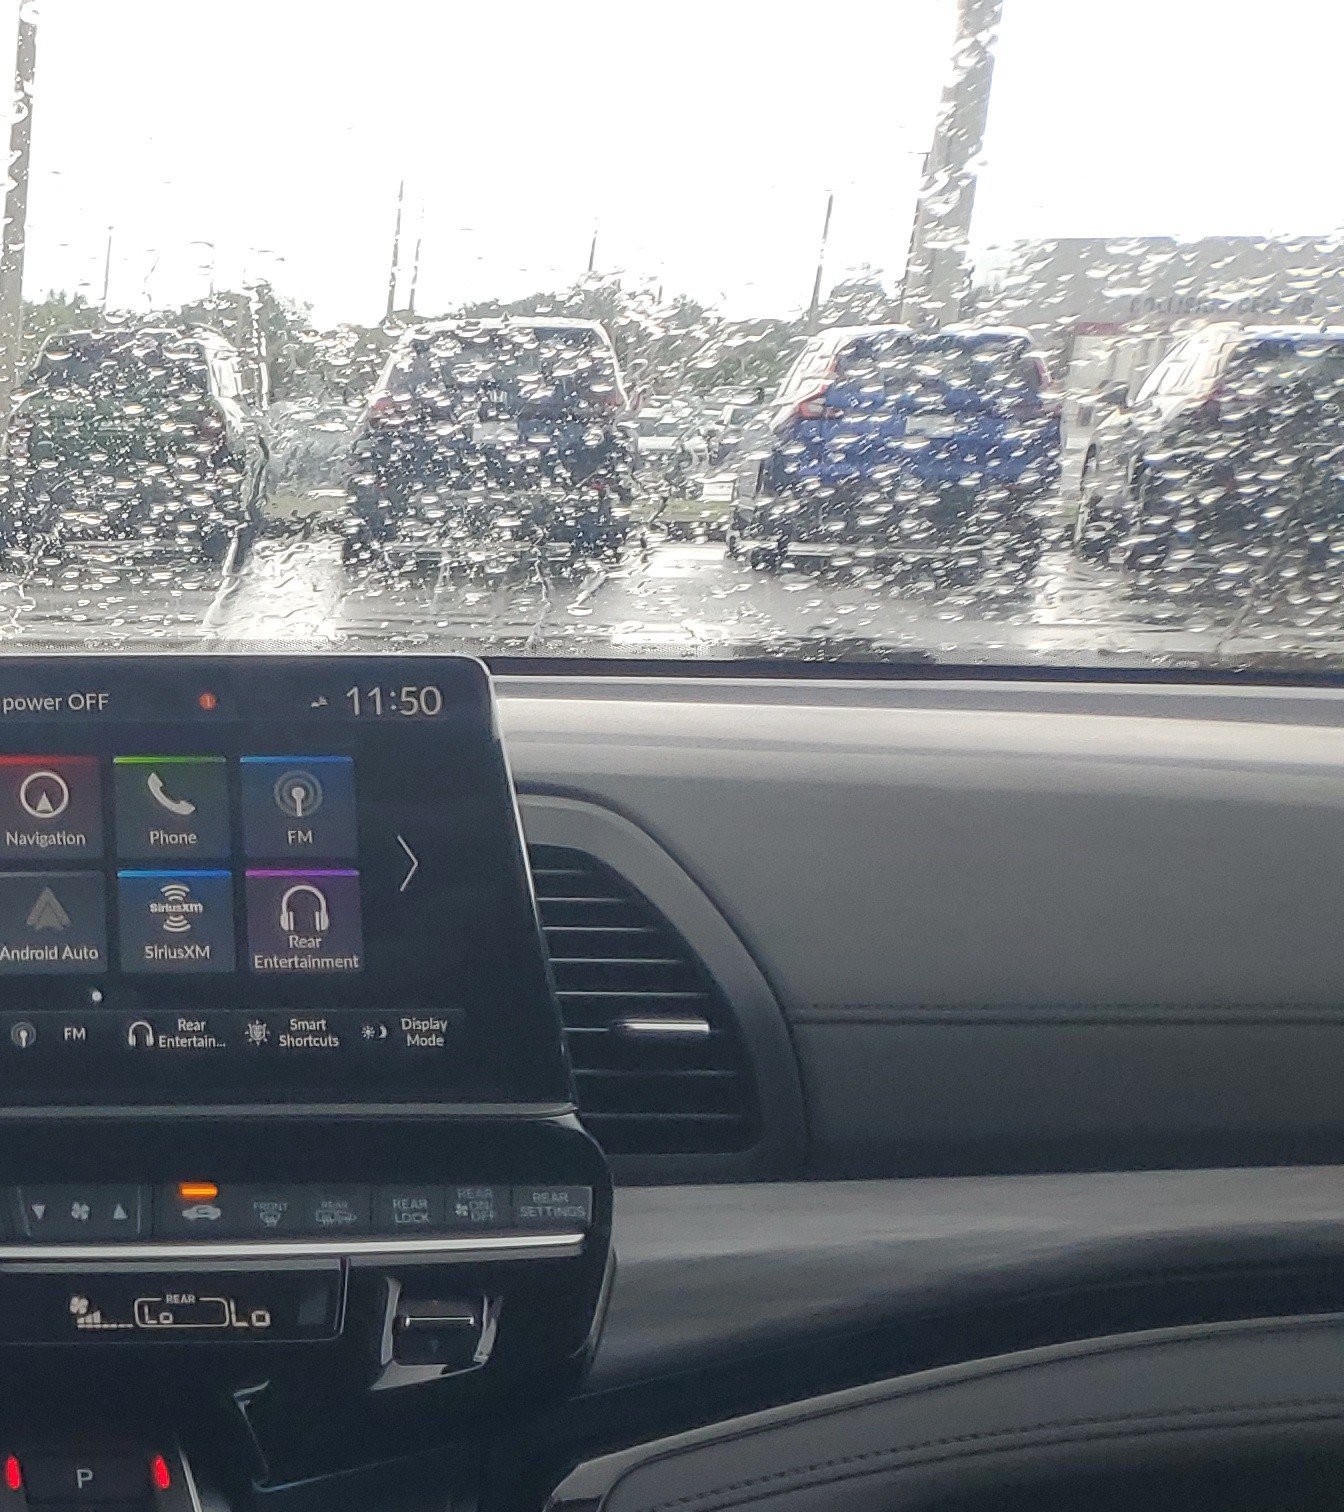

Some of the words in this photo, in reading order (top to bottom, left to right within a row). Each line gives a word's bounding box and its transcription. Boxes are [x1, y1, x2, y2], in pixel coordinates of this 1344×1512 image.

[3, 697, 62, 716] power
[68, 693, 110, 711] OFF
[345, 685, 443, 717] 11:50
[5, 830, 86, 849] Navigation
[149, 830, 198, 845] Phone
[287, 830, 313, 844] FM
[289, 935, 322, 949] Rear
[0, 946, 58, 961] Android
[62, 945, 99, 960] Auto
[145, 944, 210, 960] SiriusXM
[254, 954, 359, 969] Entertainment
[177, 1018, 206, 1032] Rear
[289, 1018, 326, 1031] Smart
[400, 1017, 448, 1034] Display
[63, 1027, 87, 1041] FM
[278, 1033, 340, 1048] Shortcuts
[406, 1033, 445, 1047] Mode
[158, 1035, 227, 1049] Entertain...
[457, 1188, 494, 1199] REAR
[532, 1192, 569, 1204] REAR
[392, 1199, 429, 1210] REAR
[394, 1212, 431, 1224] LOCK
[519, 1206, 587, 1219] SETTINGS
[166, 1294, 197, 1305] REAR
[76, 1468, 94, 1489] P
